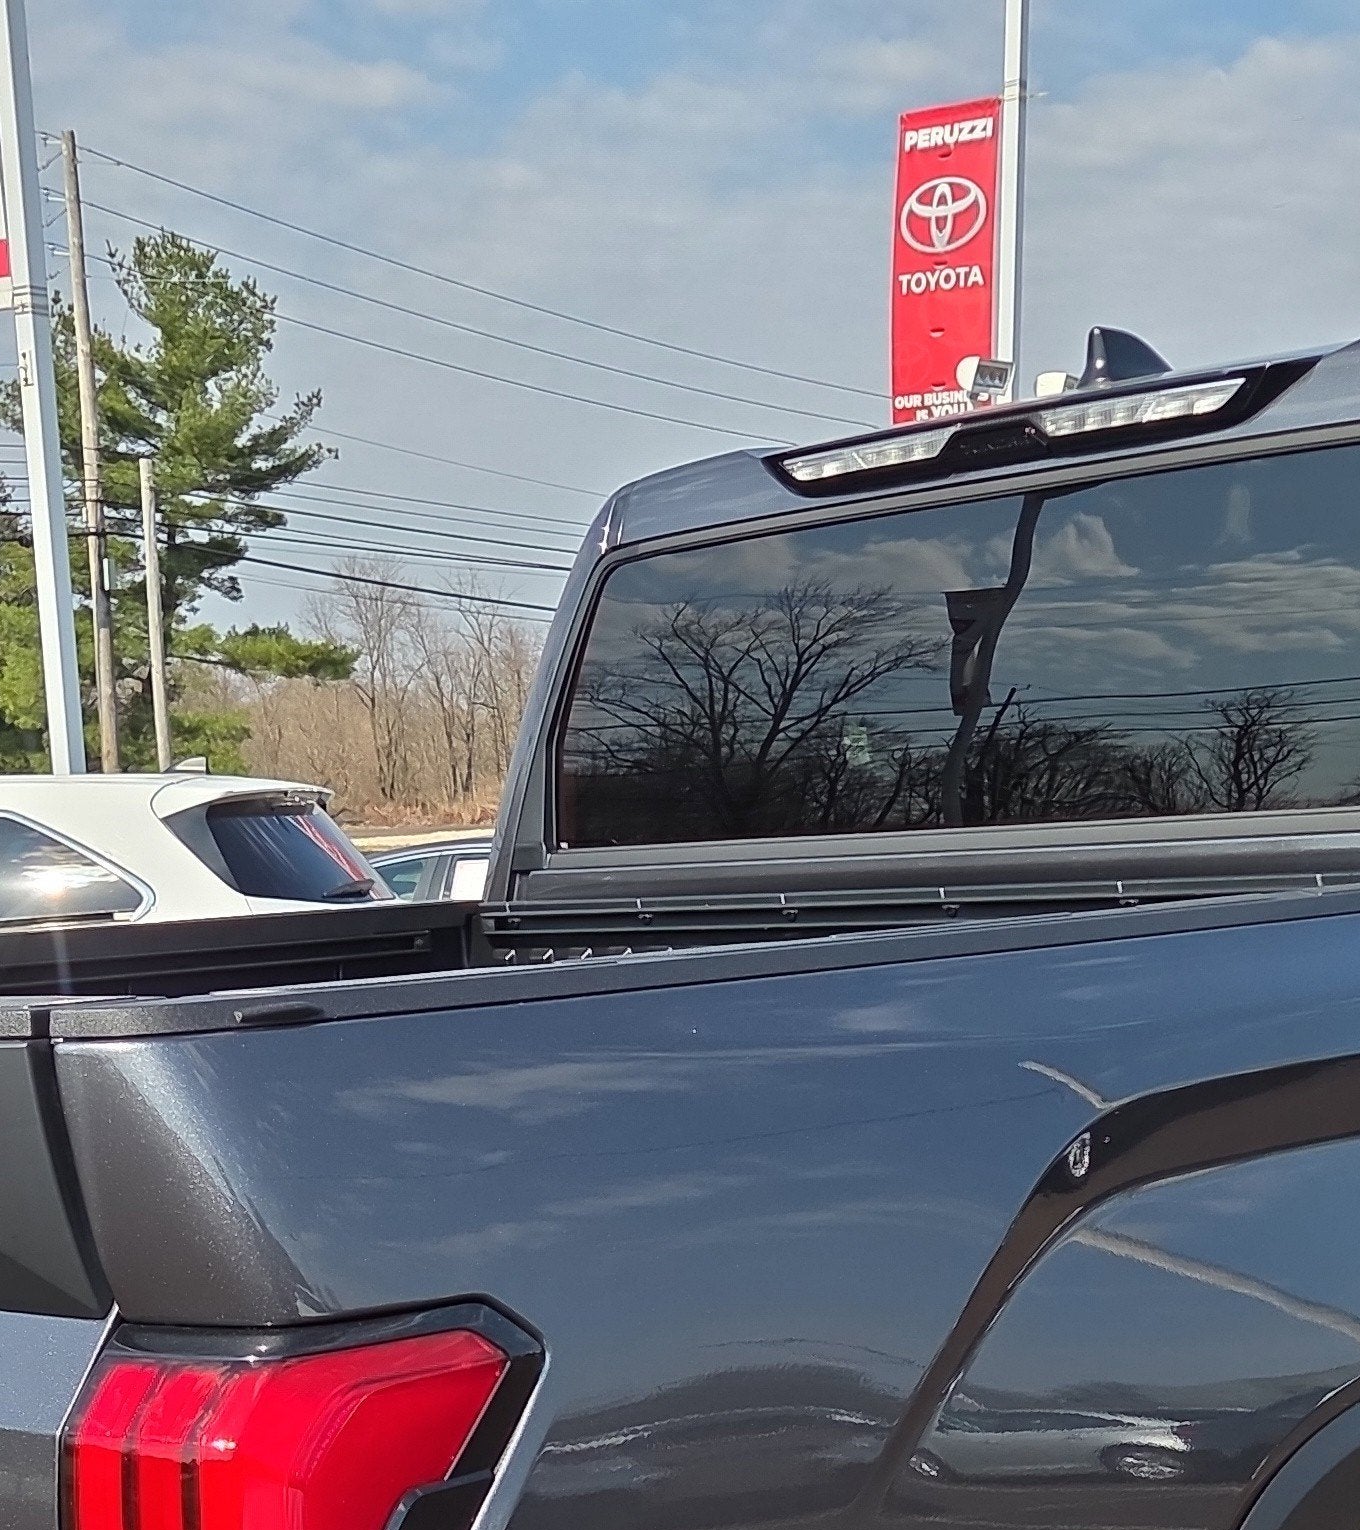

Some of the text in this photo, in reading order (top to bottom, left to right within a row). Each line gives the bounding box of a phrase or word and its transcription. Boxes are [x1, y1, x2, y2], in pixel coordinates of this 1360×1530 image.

[903, 116, 994, 154] PERUZZI
[898, 264, 985, 296] TOYOTA
[894, 394, 923, 410] OUR
